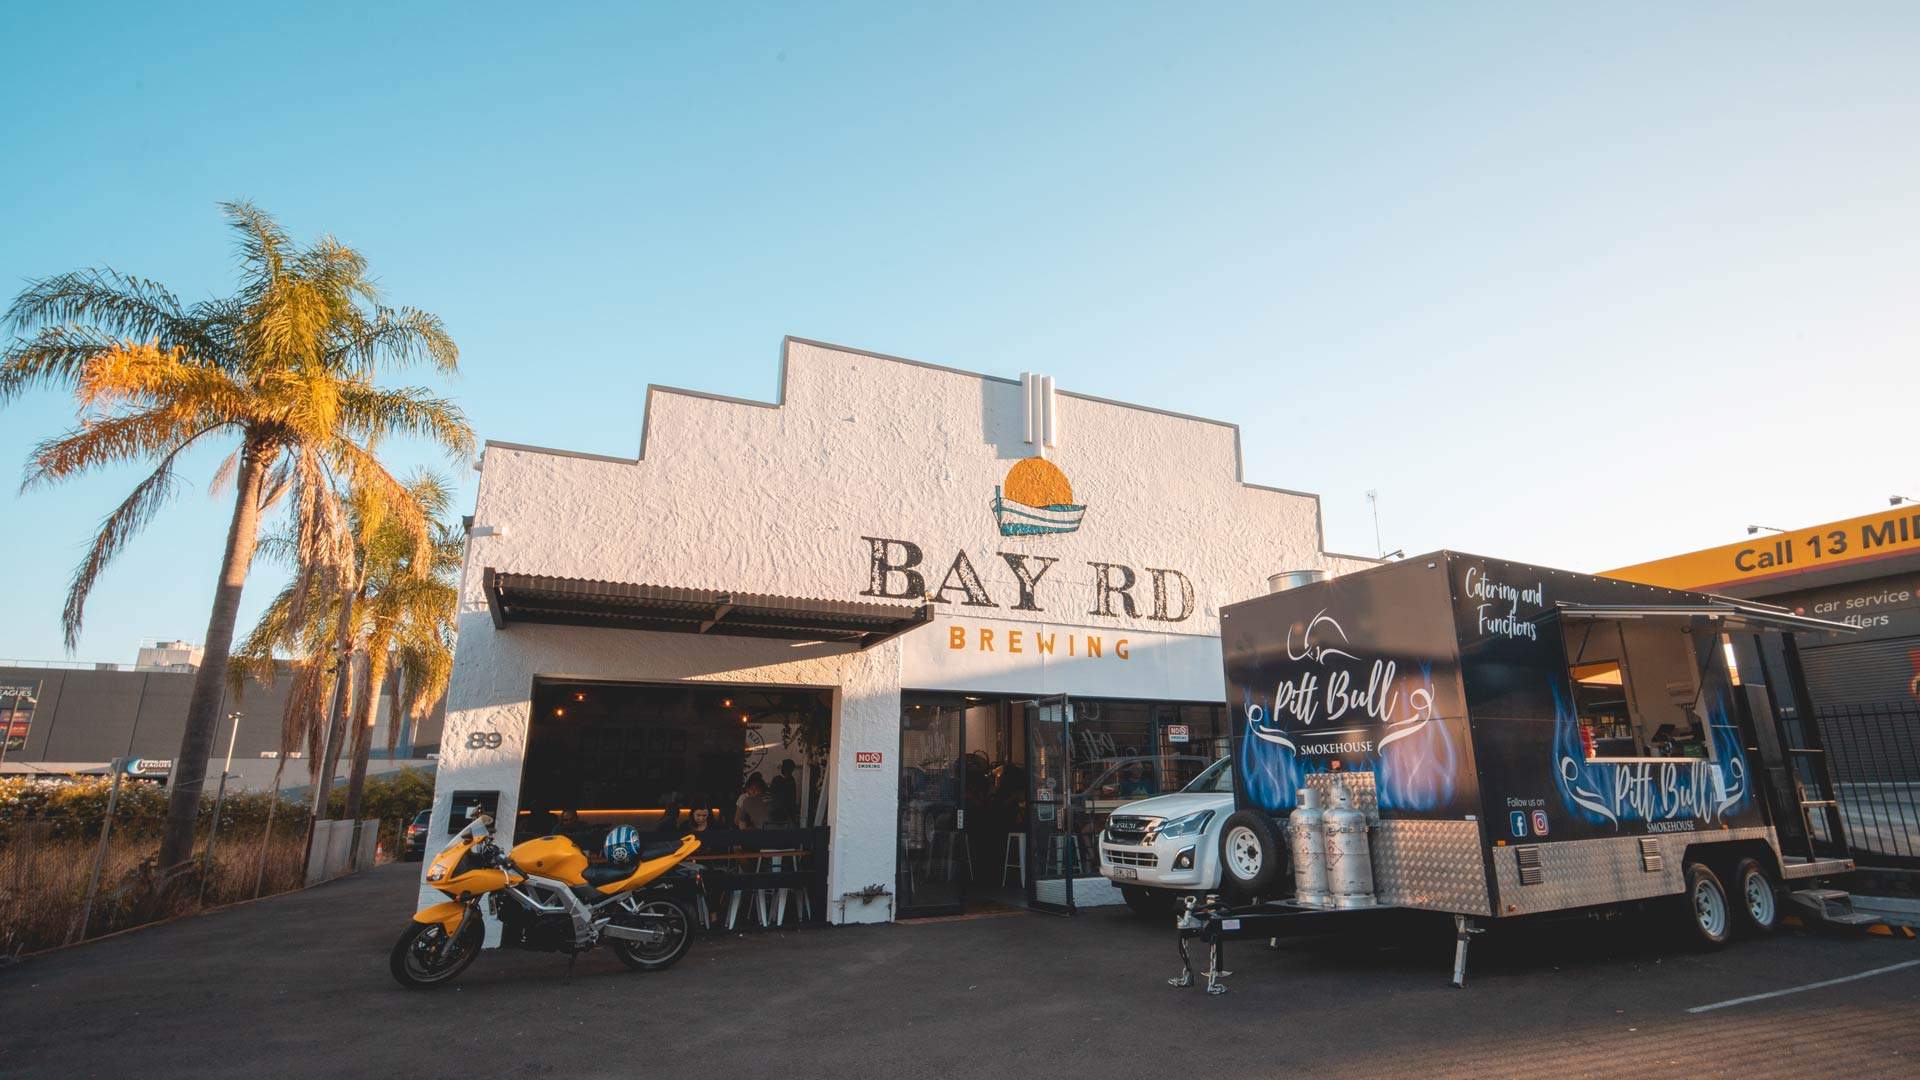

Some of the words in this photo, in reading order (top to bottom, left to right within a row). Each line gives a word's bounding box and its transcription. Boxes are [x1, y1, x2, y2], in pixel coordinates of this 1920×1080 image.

[1735, 540, 1793, 572] Call
[1807, 530, 1848, 558] 13
[859, 535, 1060, 612] BAY
[1087, 561, 1195, 622] RD
[1465, 567, 1519, 614] Catering
[1522, 582, 1543, 607] and
[1814, 601, 1840, 614] car
[1846, 590, 1910, 609] service
[1477, 603, 1537, 641] Functions
[1841, 614, 1889, 628] fflers
[950, 625, 1130, 660] BREWING
[1273, 671, 1319, 726] Pitt
[1326, 659, 1399, 722] Bull
[468, 731, 502, 749] 89
[1300, 741, 1373, 755] SMOKEHOUSE
[858, 753, 871, 762] NO
[1507, 797, 1527, 807] Follow
[1536, 799, 1545, 807] on
[1615, 761, 1655, 823] Pitt
[1661, 760, 1713, 824] Bull
[1646, 820, 1695, 834] SMOKEHOUSE
